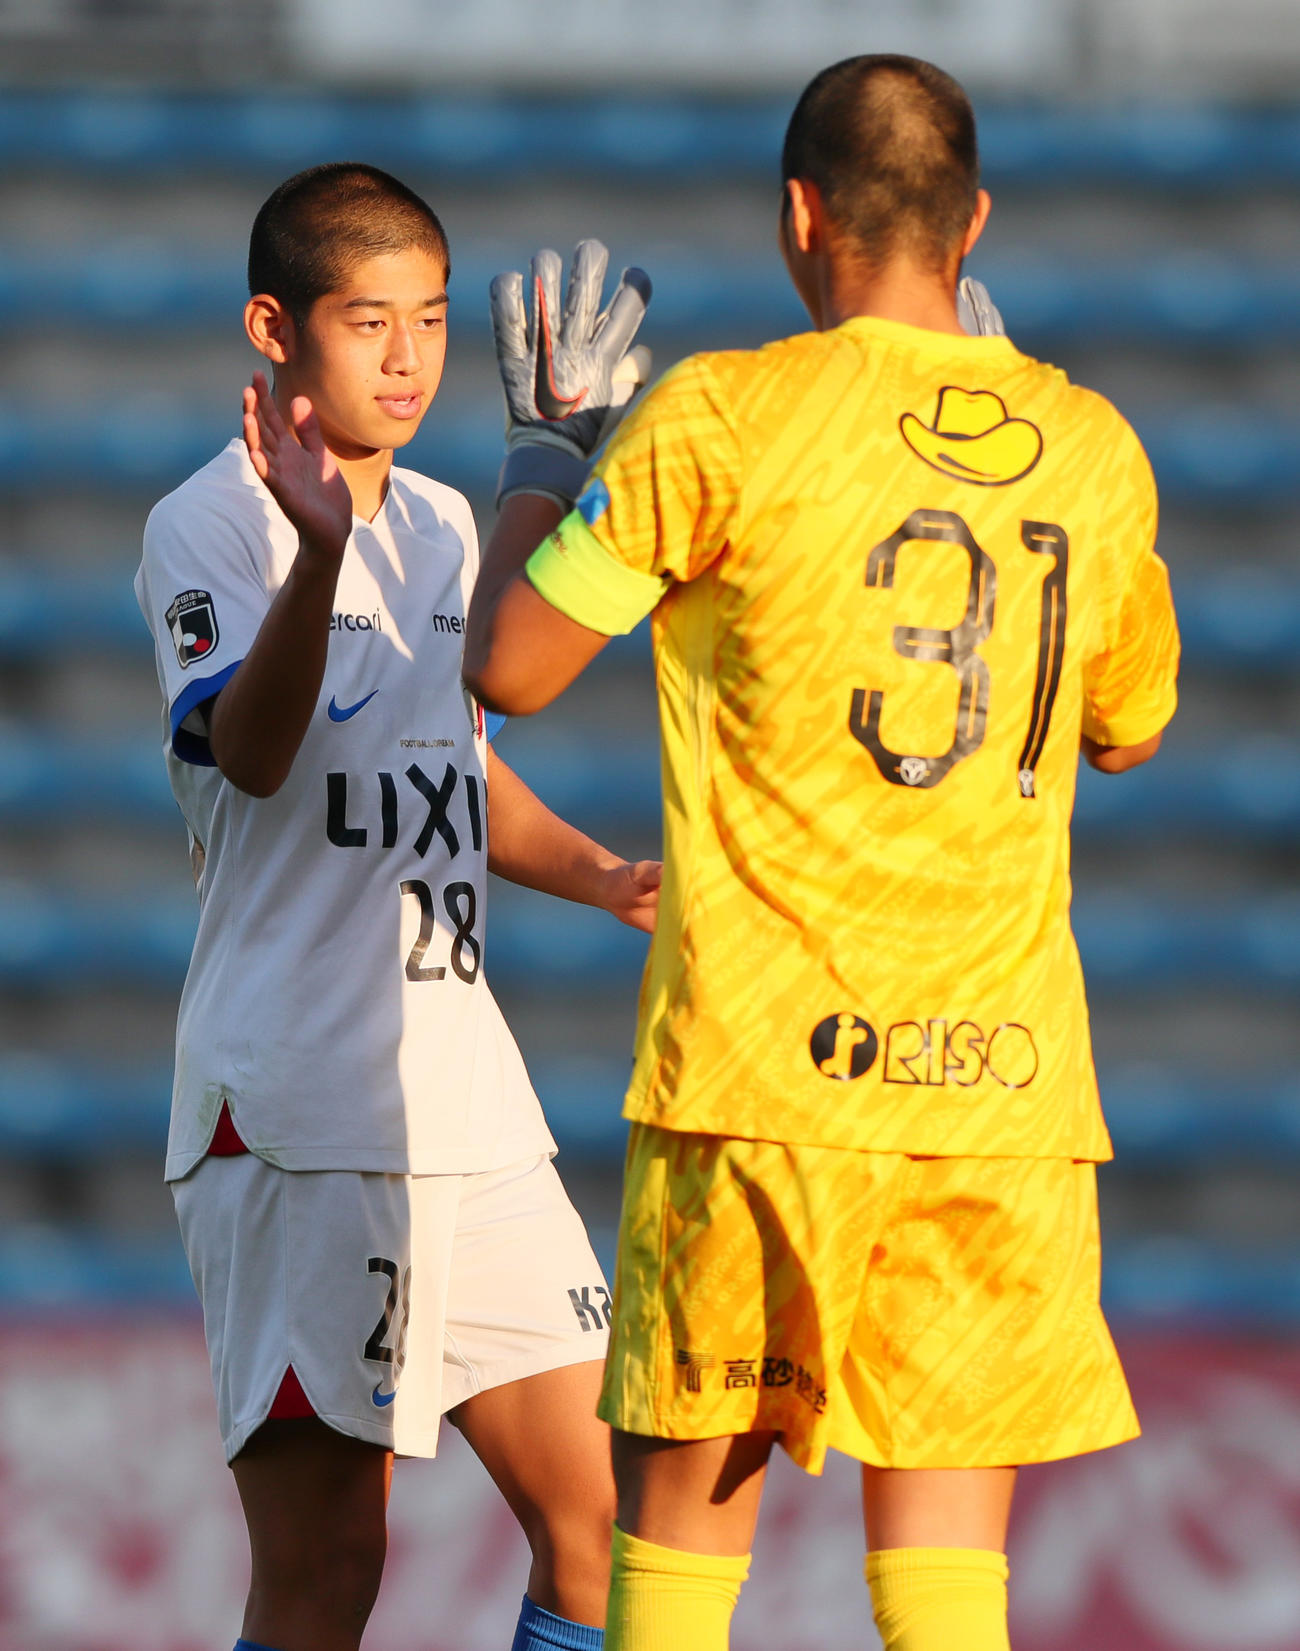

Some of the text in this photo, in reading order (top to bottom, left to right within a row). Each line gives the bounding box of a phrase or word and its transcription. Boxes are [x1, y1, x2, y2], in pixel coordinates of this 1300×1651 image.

[329, 607, 382, 632] ercari
[848, 508, 1069, 798] 31
[326, 761, 488, 860] LIXI
[399, 879, 481, 986] 28
[883, 1019, 1039, 1089] RISO
